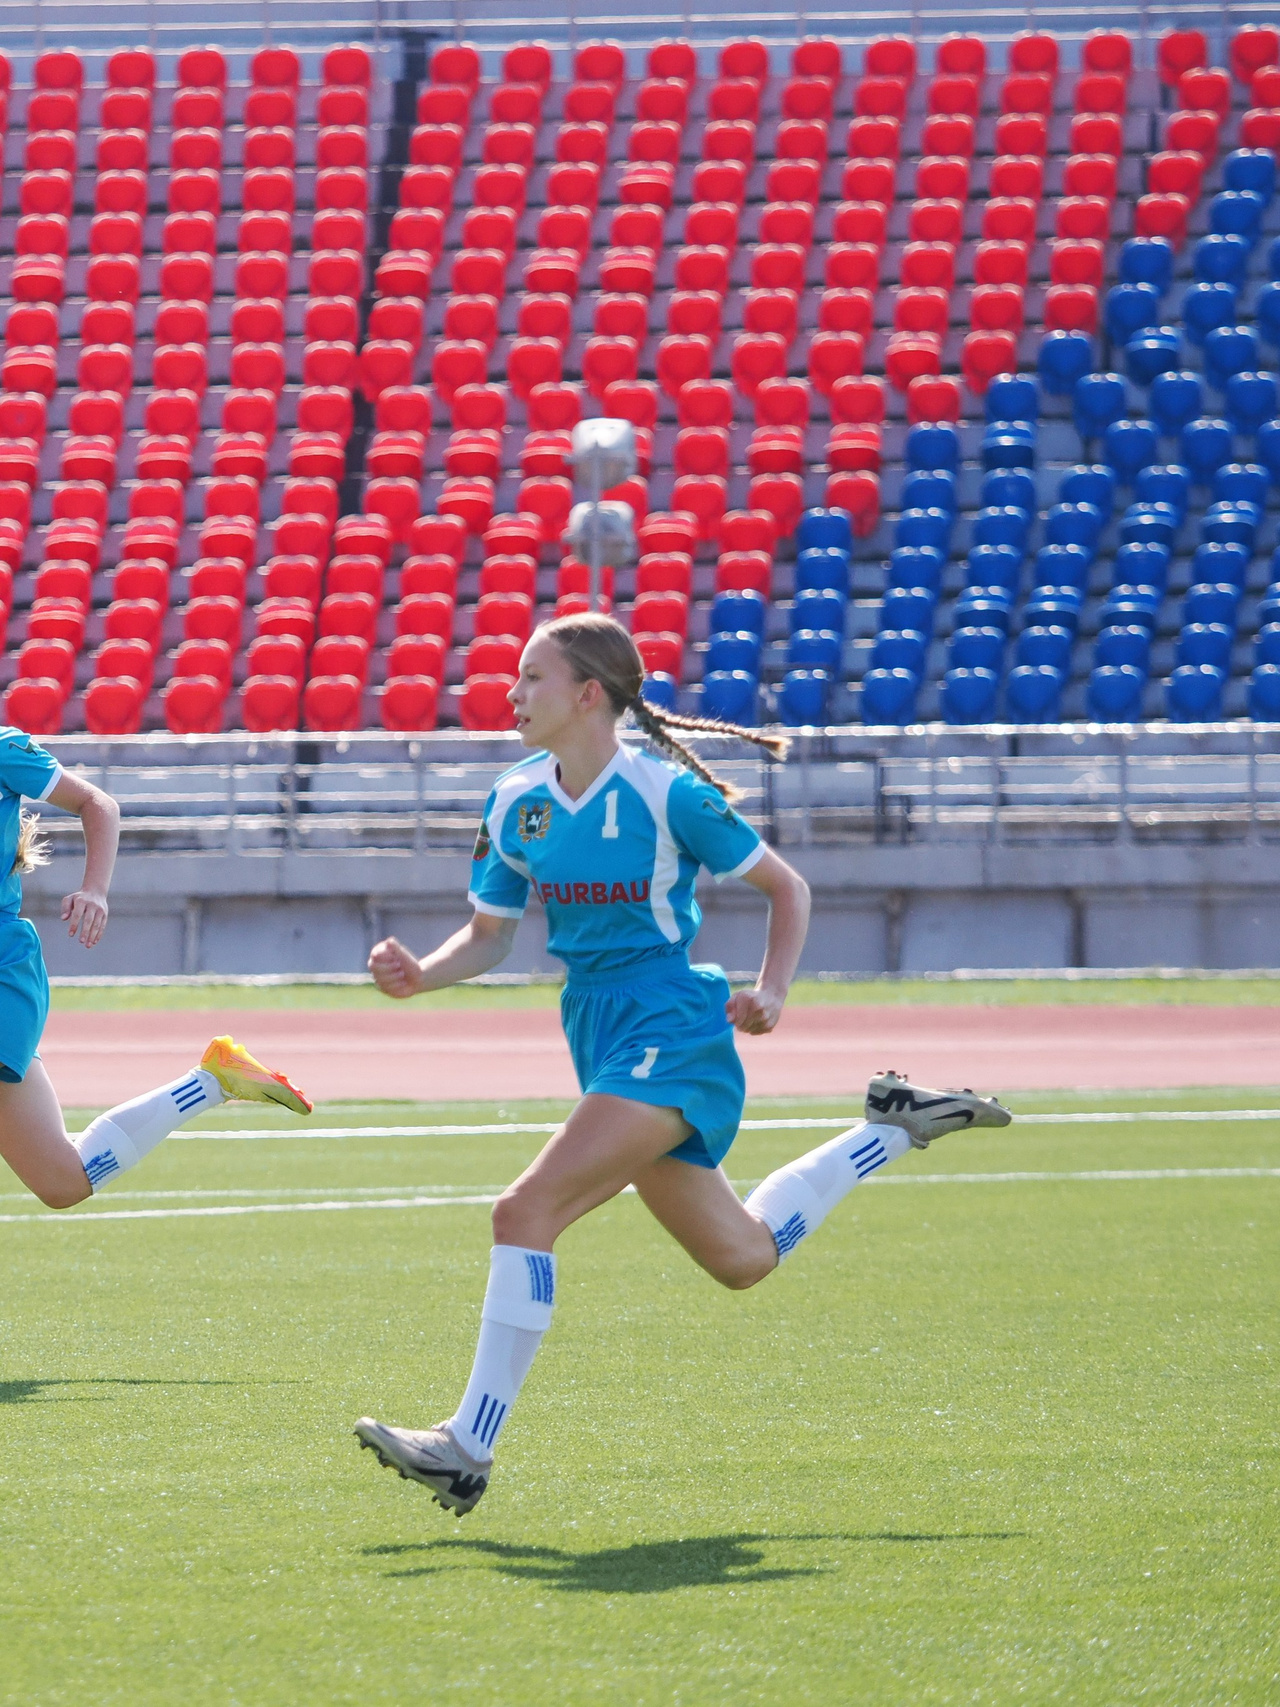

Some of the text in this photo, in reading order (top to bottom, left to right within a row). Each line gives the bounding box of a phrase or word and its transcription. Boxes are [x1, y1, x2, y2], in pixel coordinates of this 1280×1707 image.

[602, 789, 619, 838] 1
[541, 879, 649, 905] FURBAU
[631, 1046, 660, 1079] 1
